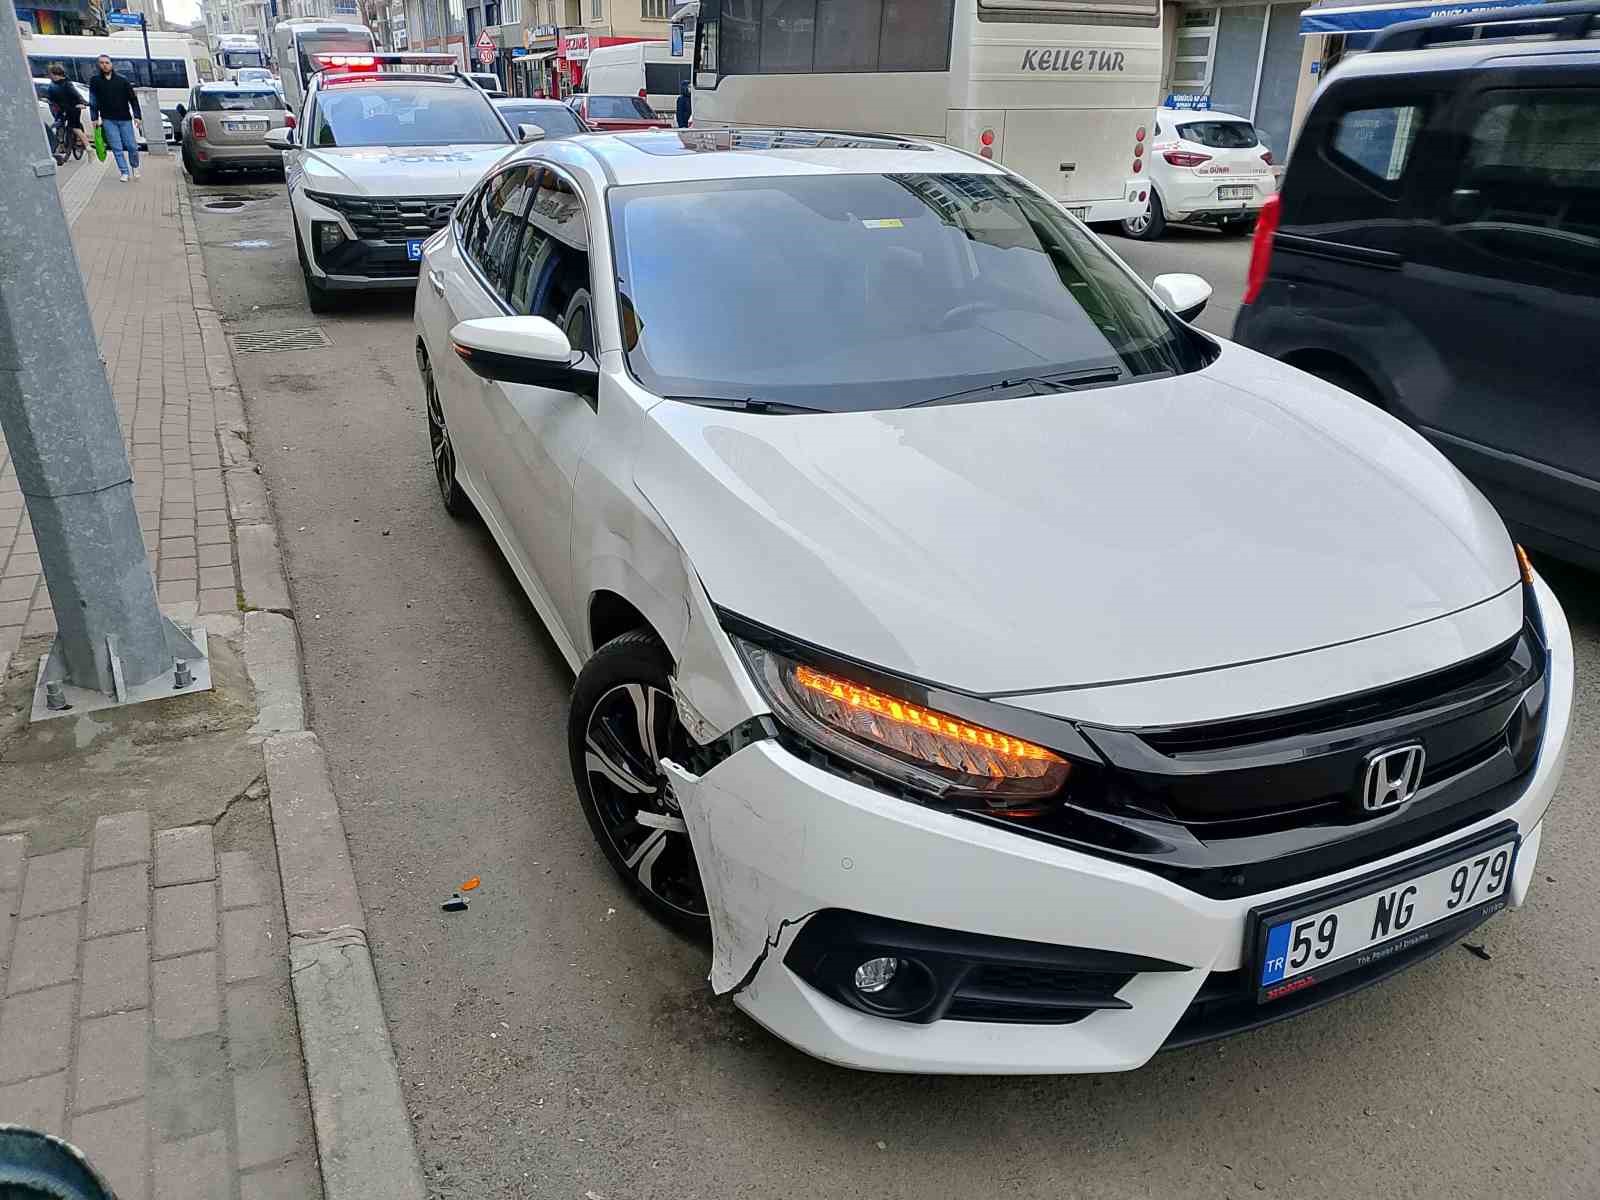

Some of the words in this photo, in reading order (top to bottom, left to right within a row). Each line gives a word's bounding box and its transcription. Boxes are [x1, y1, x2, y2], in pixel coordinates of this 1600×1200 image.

[1021, 48, 1084, 72] KELLE
[1088, 49, 1125, 72] TUR
[1290, 913, 1338, 969] 59
[1370, 885, 1417, 941] NG
[1446, 851, 1509, 910] 979
[1266, 956, 1285, 974] TR
